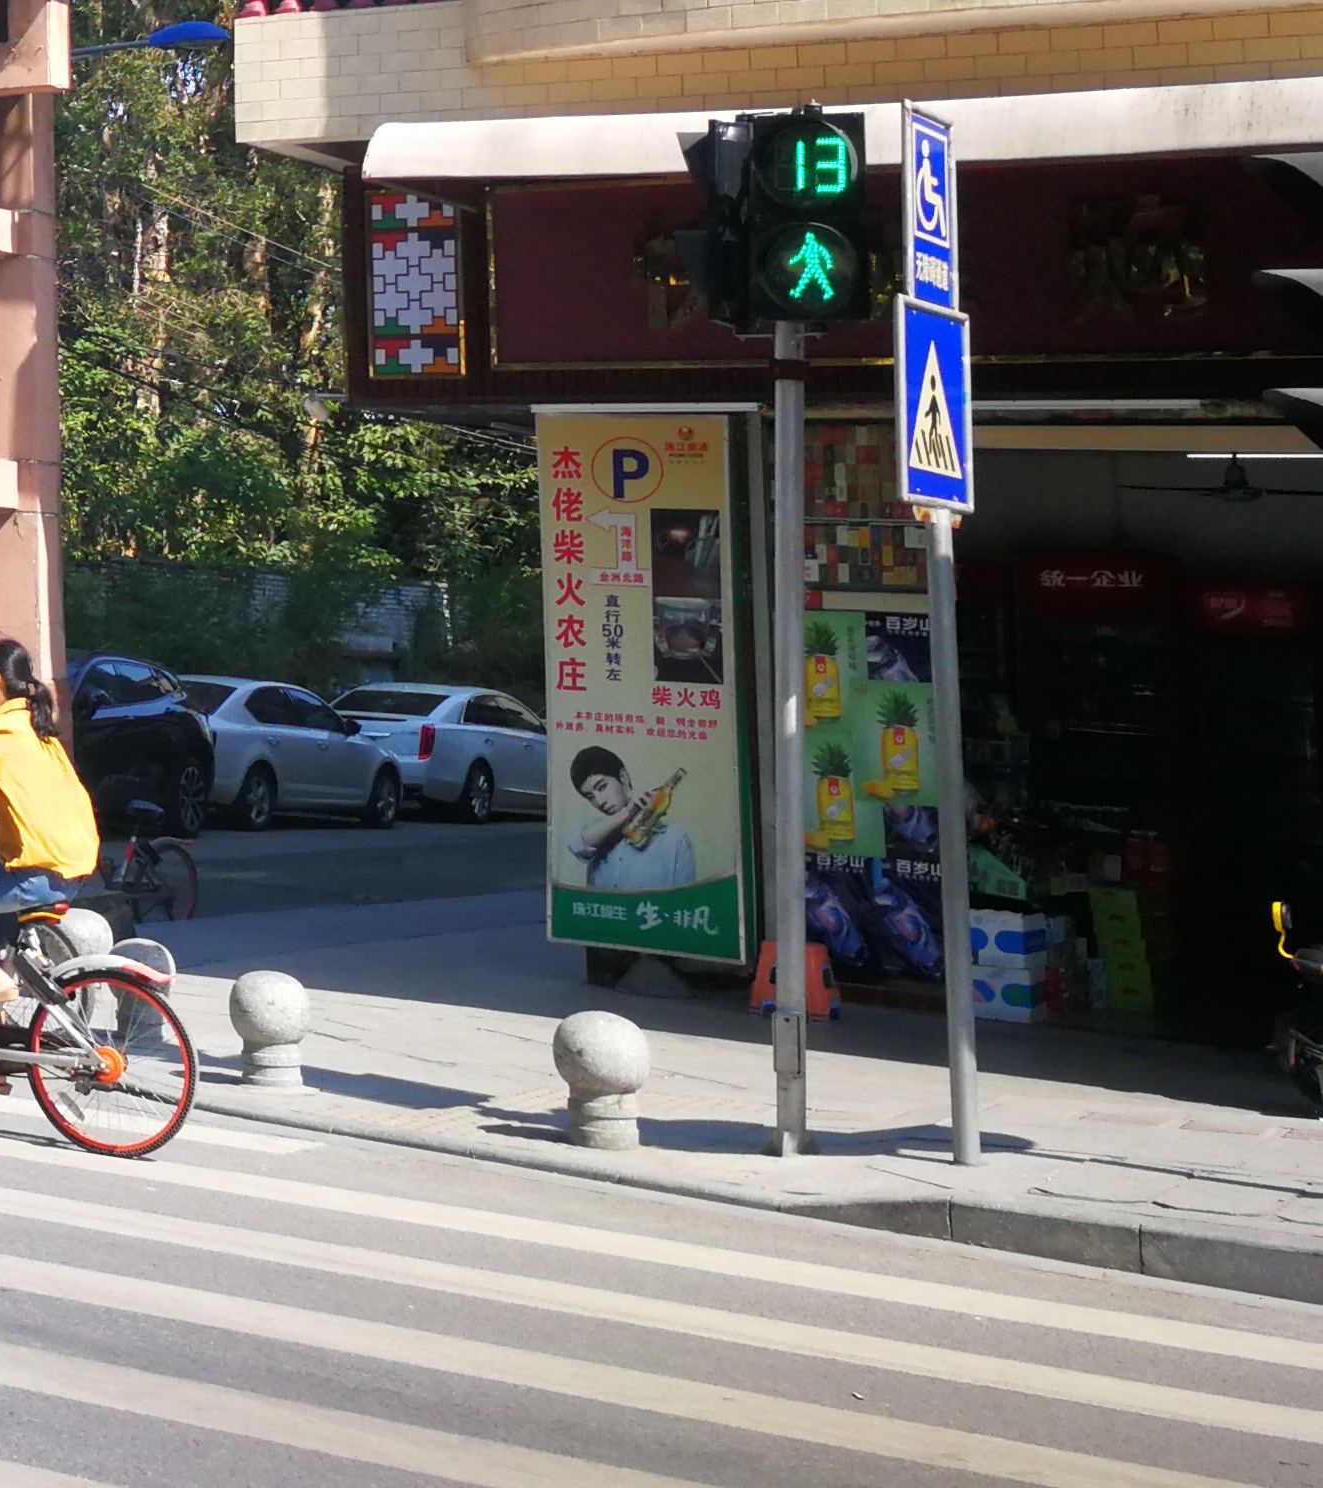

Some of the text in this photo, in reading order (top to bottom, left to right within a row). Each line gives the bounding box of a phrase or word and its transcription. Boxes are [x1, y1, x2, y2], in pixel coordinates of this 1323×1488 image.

[795, 137, 846, 193] 13
[612, 448, 650, 499] P
[551, 445, 588, 692] 杰佬柴火农庄
[1038, 569, 1144, 588] 统一企业
[651, 685, 721, 710] 柴火鸡
